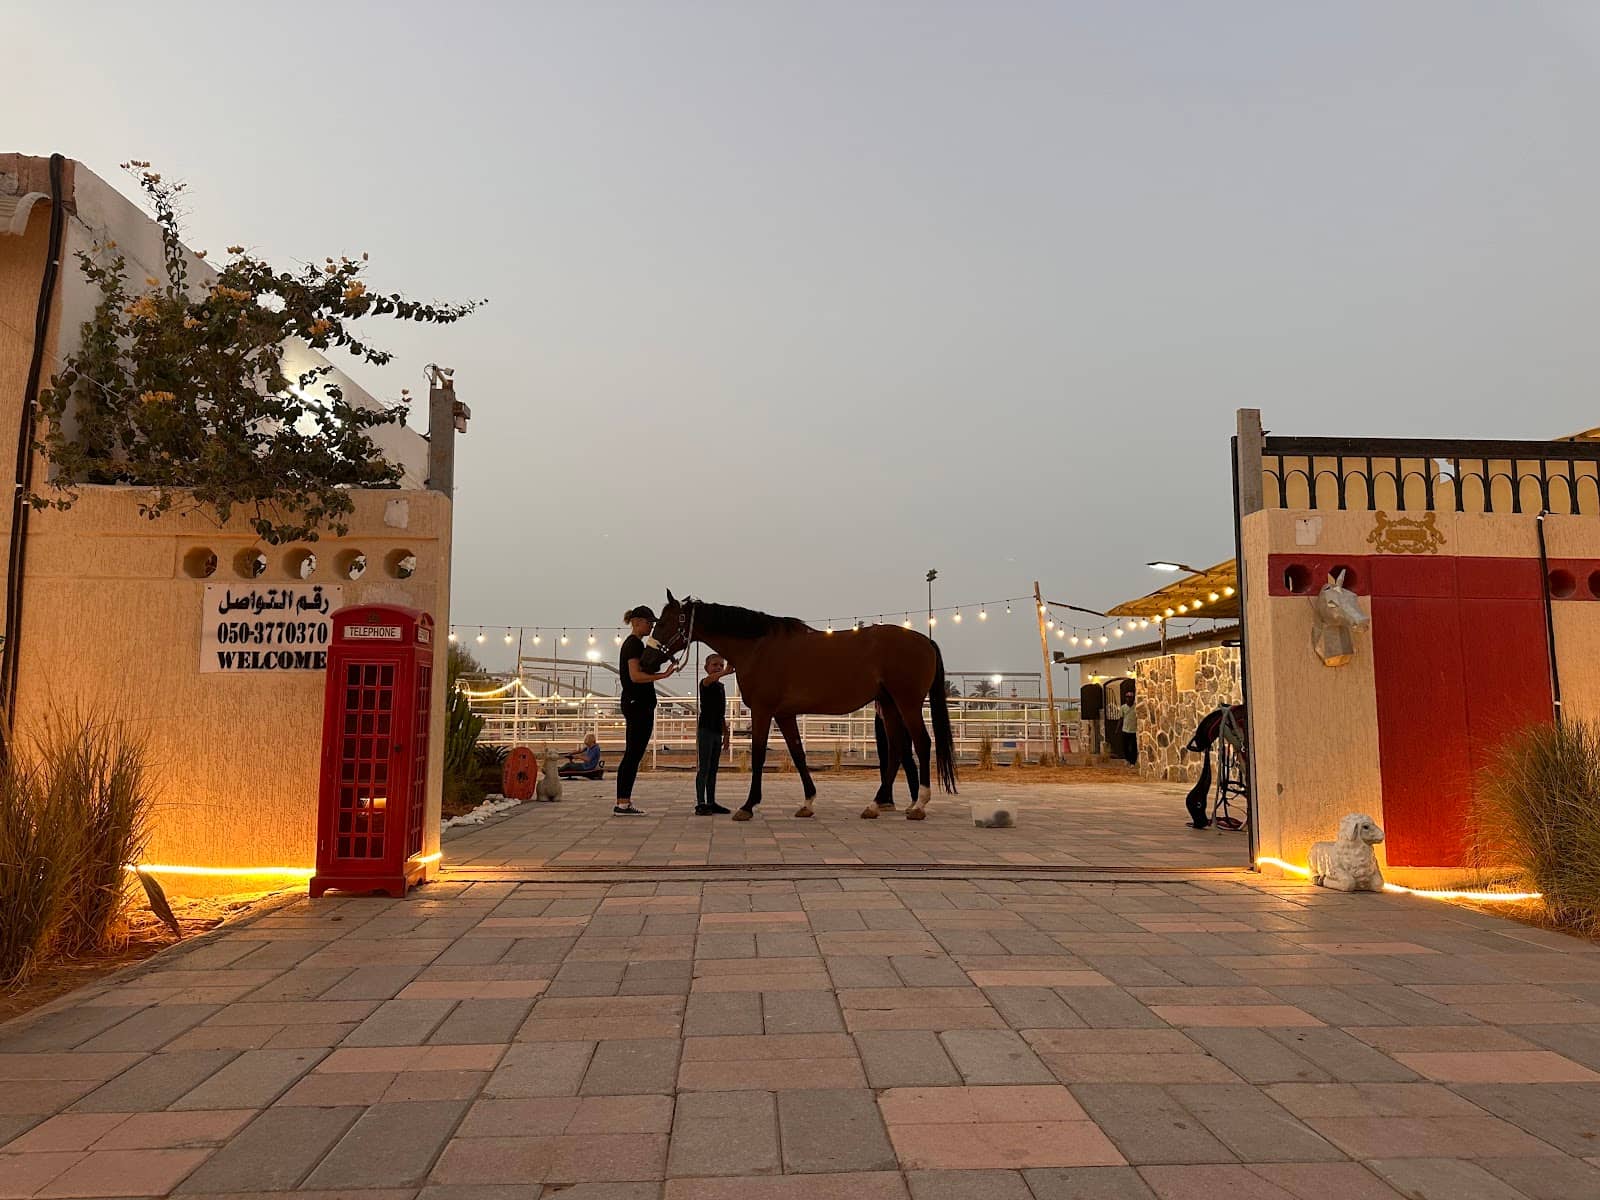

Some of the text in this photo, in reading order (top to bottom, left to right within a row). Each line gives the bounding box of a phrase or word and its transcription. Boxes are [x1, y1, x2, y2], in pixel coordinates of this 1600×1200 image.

[218, 585, 329, 616] رقم التواصل
[217, 622, 328, 644] 050-3770370
[349, 626, 397, 637] TELEPHONE
[216, 651, 327, 670] WELCOME
